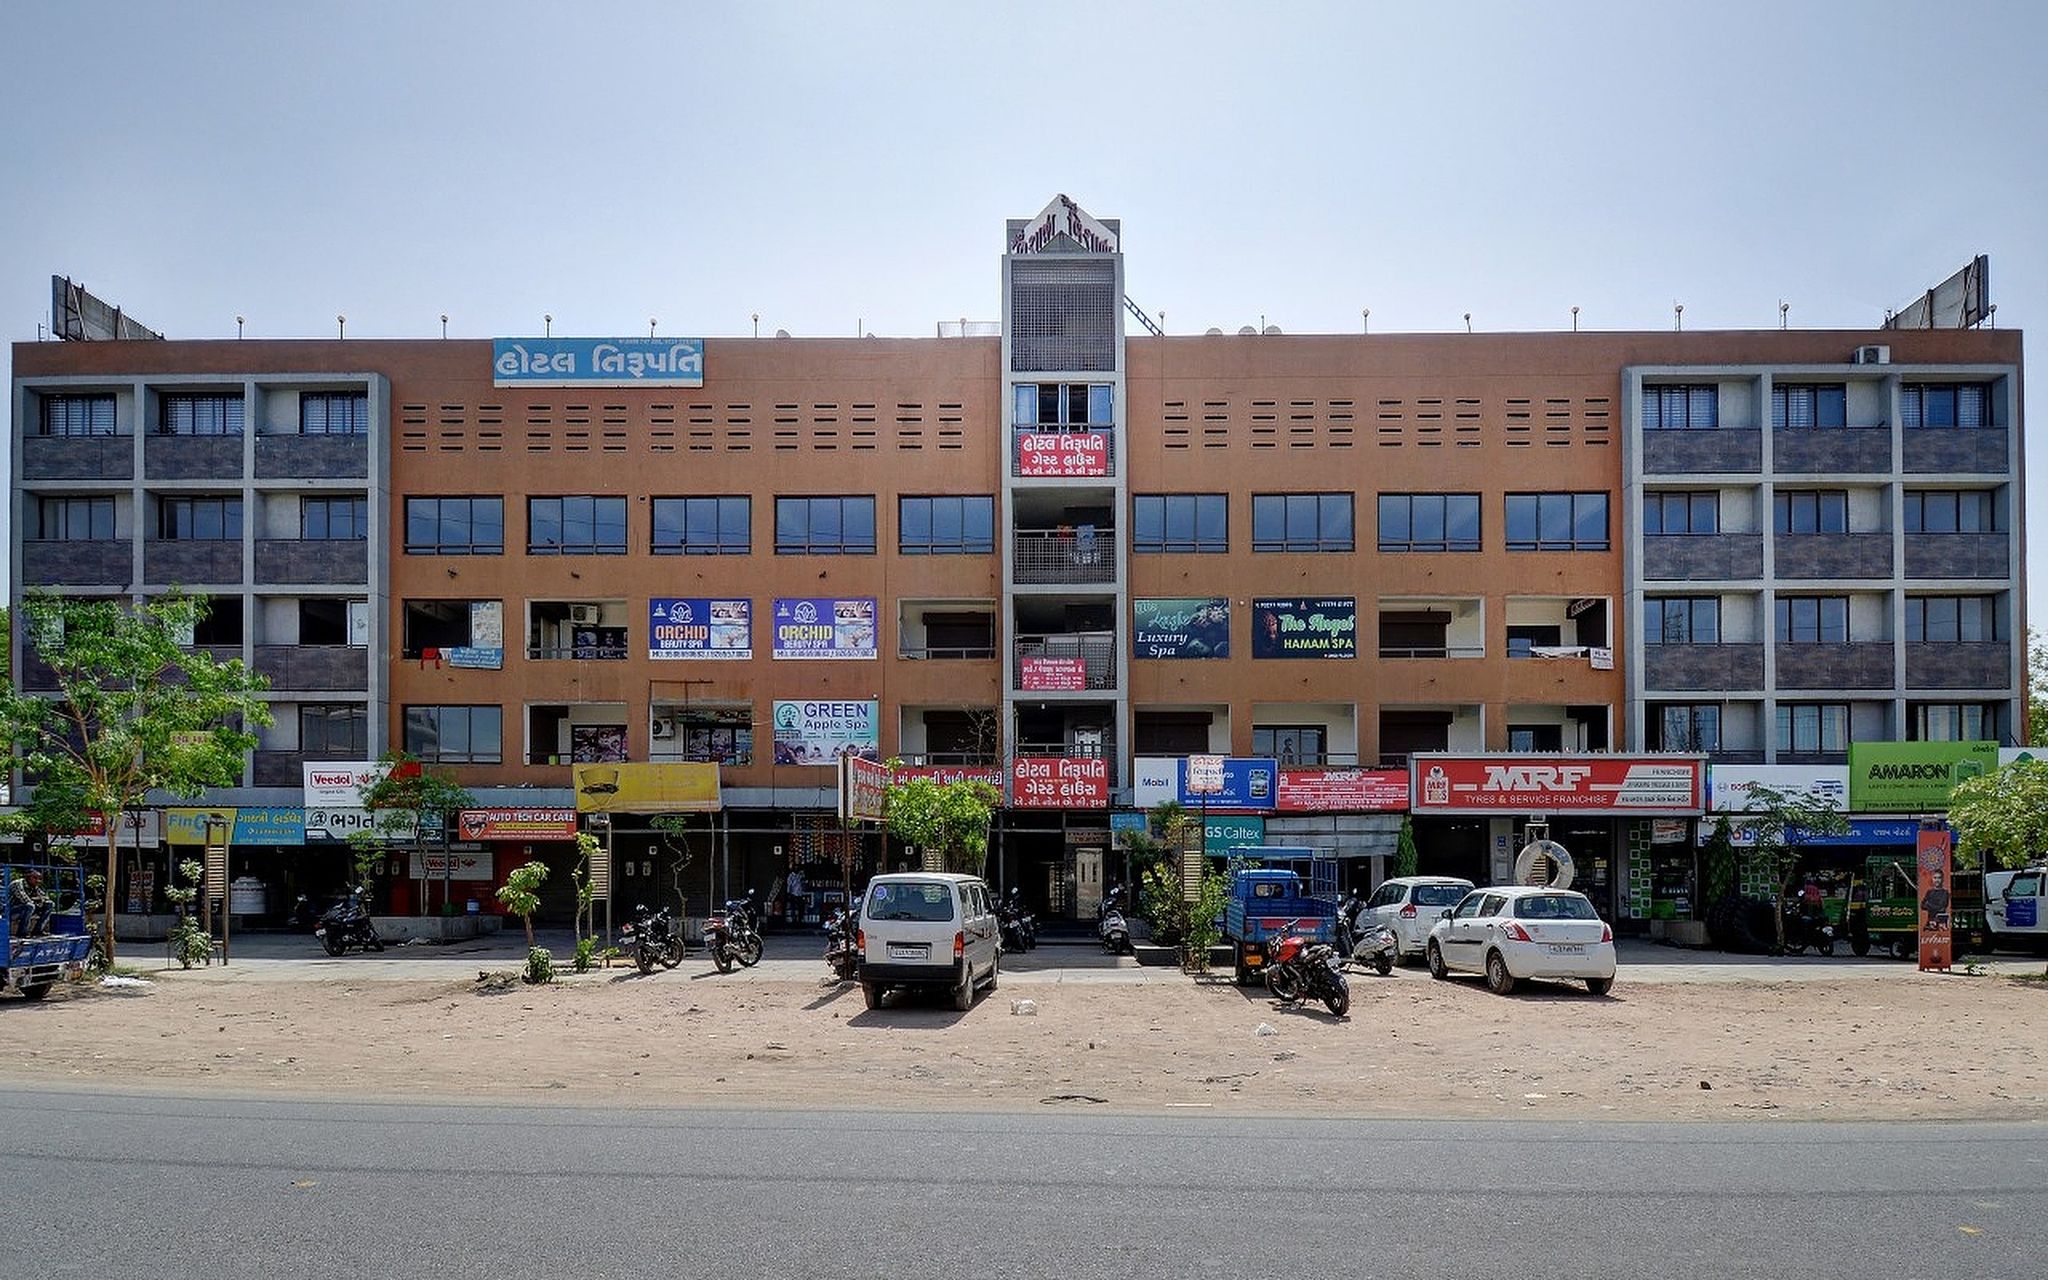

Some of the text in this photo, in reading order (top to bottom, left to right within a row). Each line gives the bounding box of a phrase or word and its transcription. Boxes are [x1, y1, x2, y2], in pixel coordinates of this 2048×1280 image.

[496, 344, 575, 375] હોટલ
[1023, 435, 1056, 452] હોટલ
[1063, 453, 1096, 466] હાઉસ
[655, 625, 709, 639] ORCHID
[778, 625, 833, 639] ORCHID
[1279, 614, 1355, 637] The Angel
[660, 640, 703, 648] BEAUTY SPA
[784, 640, 828, 649] BEAUTY SPA
[1137, 631, 1188, 646] Luxury
[1283, 639, 1354, 649] HAMAM SPA
[1149, 645, 1176, 658] Spa
[804, 703, 868, 717] GREEN
[804, 720, 869, 730] Apple Spa
[1016, 759, 1050, 778] હોટલ
[1869, 764, 1949, 779] AMARON
[314, 775, 350, 785] Veedol
[1142, 778, 1169, 787] Mobil
[1482, 766, 1591, 791] MRF
[1025, 779, 1096, 796] ગેસ્ટ હાઉસ
[1427, 781, 1447, 791] MRF
[1464, 795, 1608, 804] TYRES & SERVICE FRANCHISE
[331, 814, 374, 828] ભગત
[489, 812, 574, 821] AUTO TECH CAR CARE
[1205, 826, 1260, 839] GS Caltex
